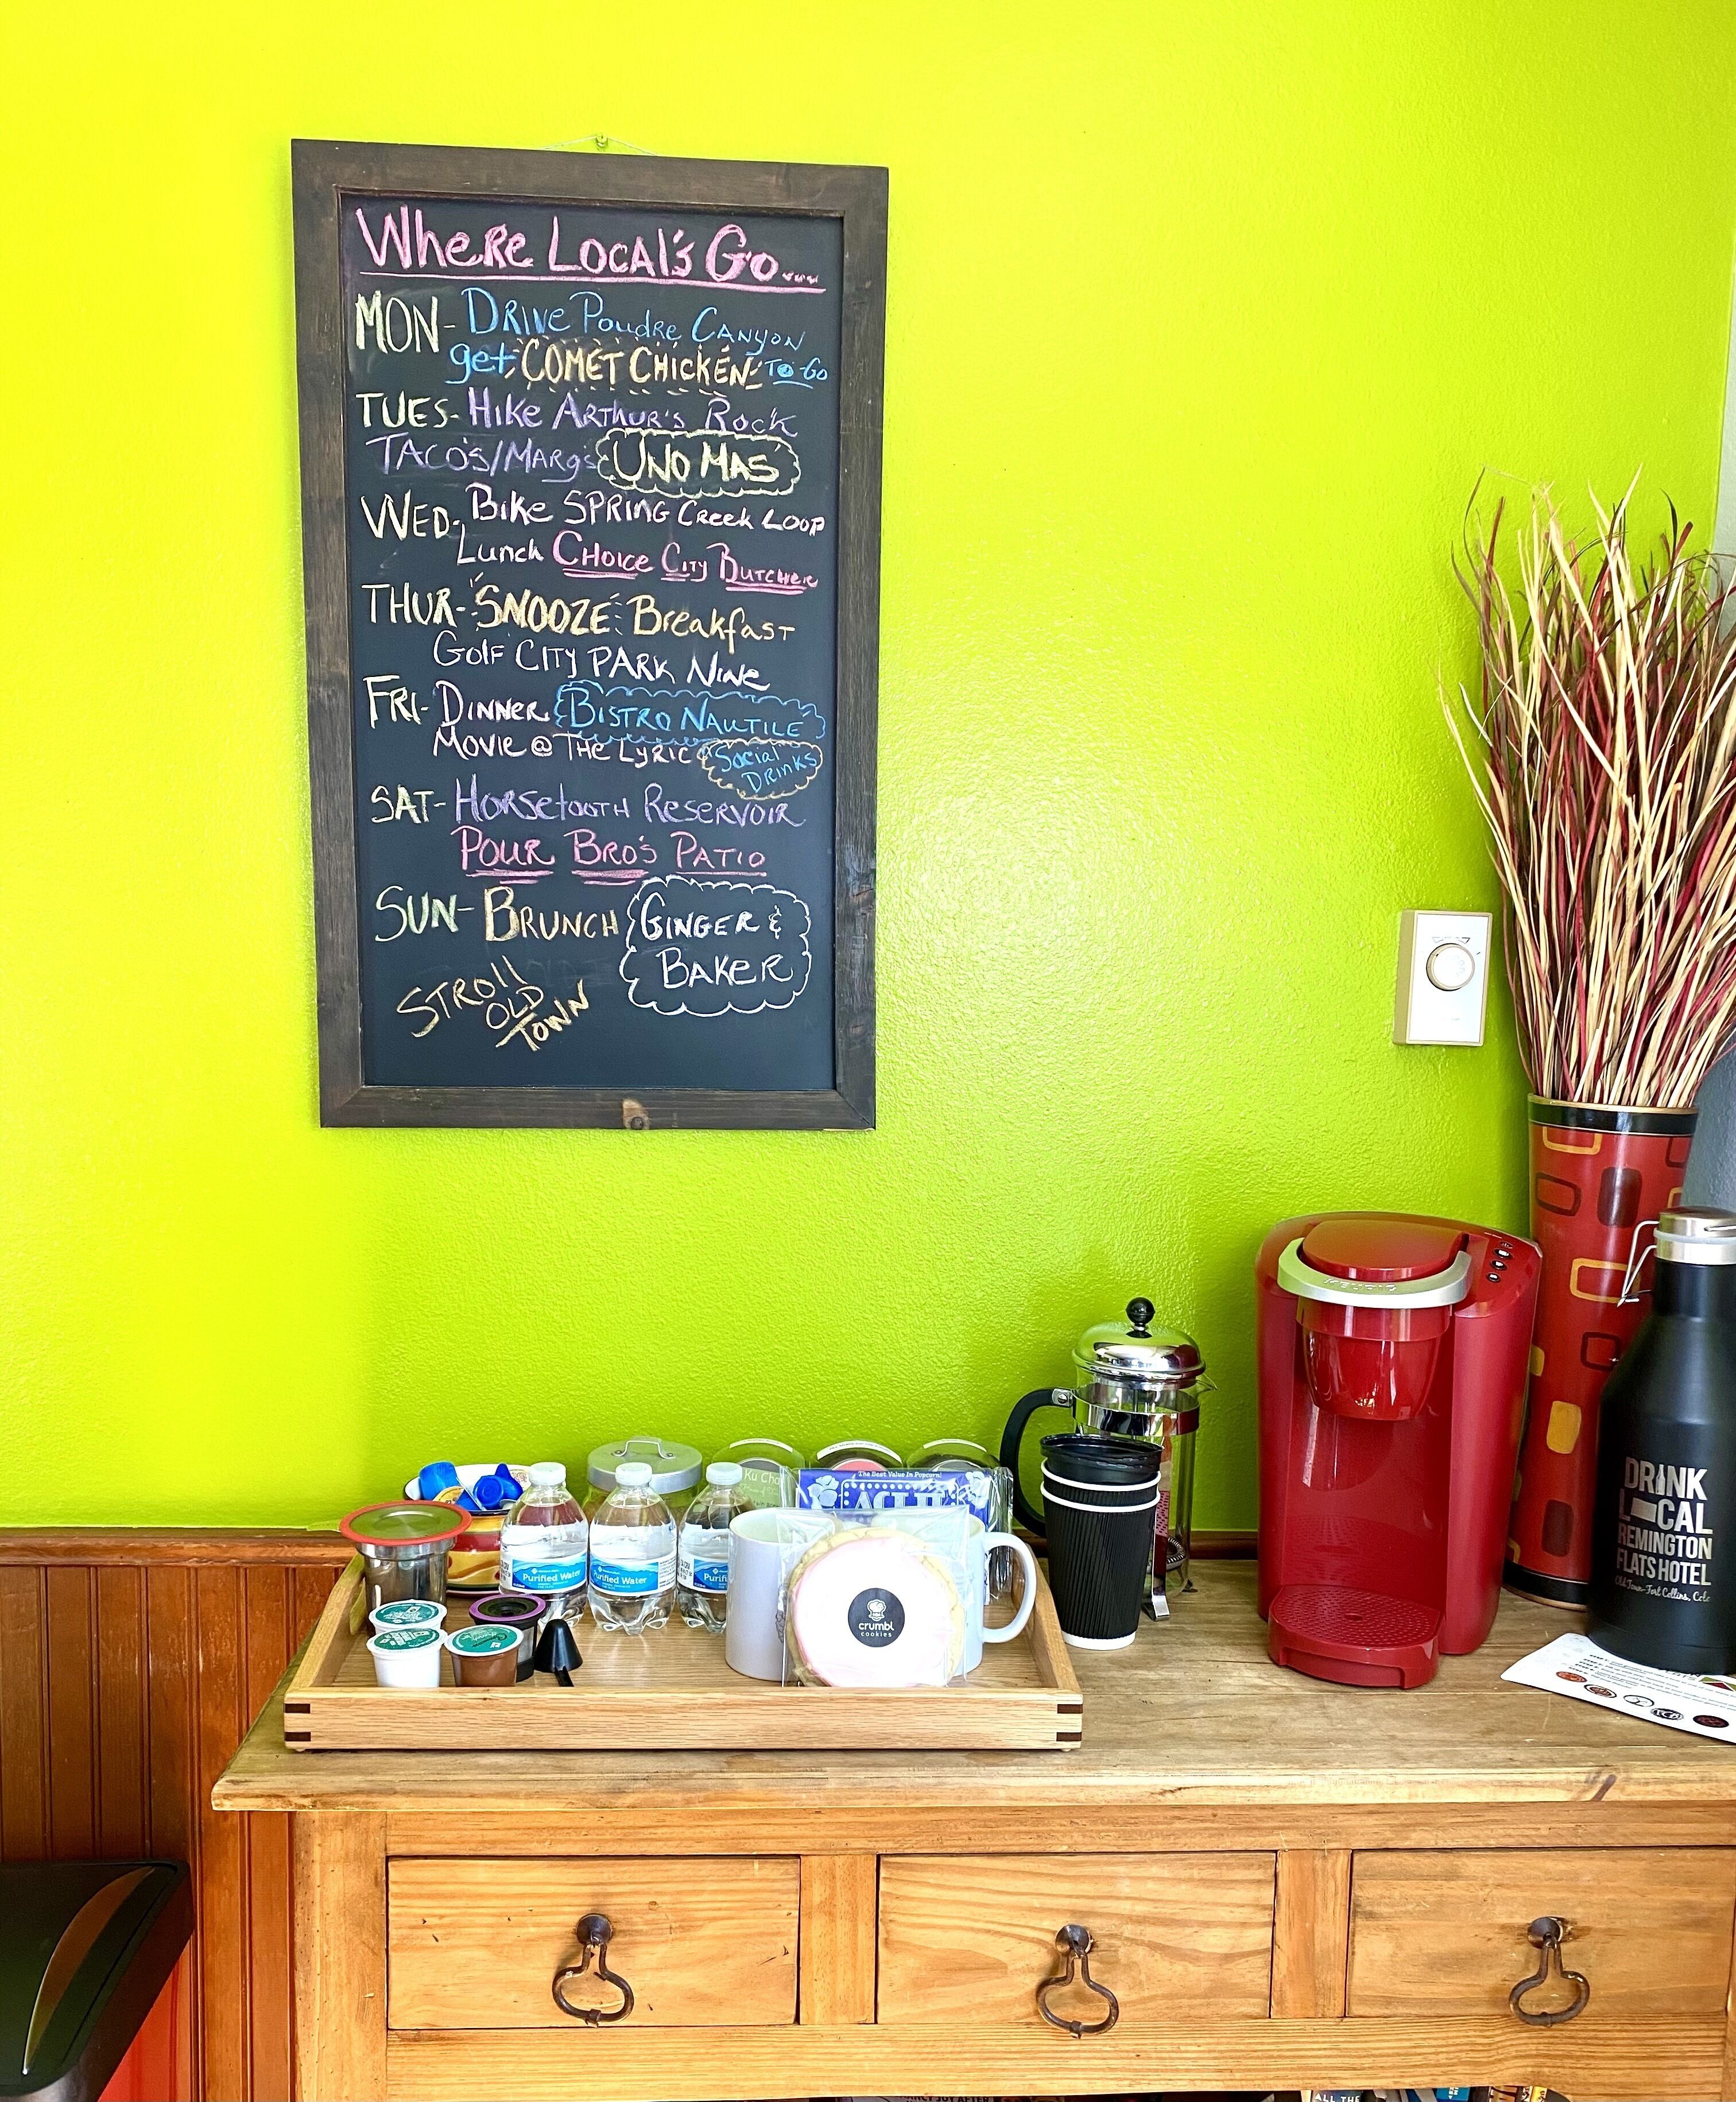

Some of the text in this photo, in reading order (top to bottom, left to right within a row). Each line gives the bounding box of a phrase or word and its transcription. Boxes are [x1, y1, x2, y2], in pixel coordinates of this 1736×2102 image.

[445, 342, 516, 384] get
[521, 338, 625, 385] COMET
[613, 433, 690, 483] UNO
[700, 441, 780, 482] MAS
[475, 584, 611, 636] SNOOZE
[531, 735, 553, 757] @
[484, 886, 619, 941] BRUNCH
[640, 892, 782, 940] GINGER &
[486, 985, 544, 1029] OLD
[495, 979, 590, 1052] TOWN
[744, 1469, 757, 1481] Ku
[1624, 1456, 1708, 1501] DRINK
[1619, 1488, 1713, 1535] LCAL
[1618, 1522, 1712, 1559] REMINGTON
[523, 1569, 581, 1582] Purified Water
[594, 1569, 619, 1584] Purified
[622, 1577, 647, 1585] Water
[704, 1573, 727, 1582] Purifi
[1616, 1547, 1711, 1585] FLATS HOTEL
[858, 1621, 894, 1631] crumbl
